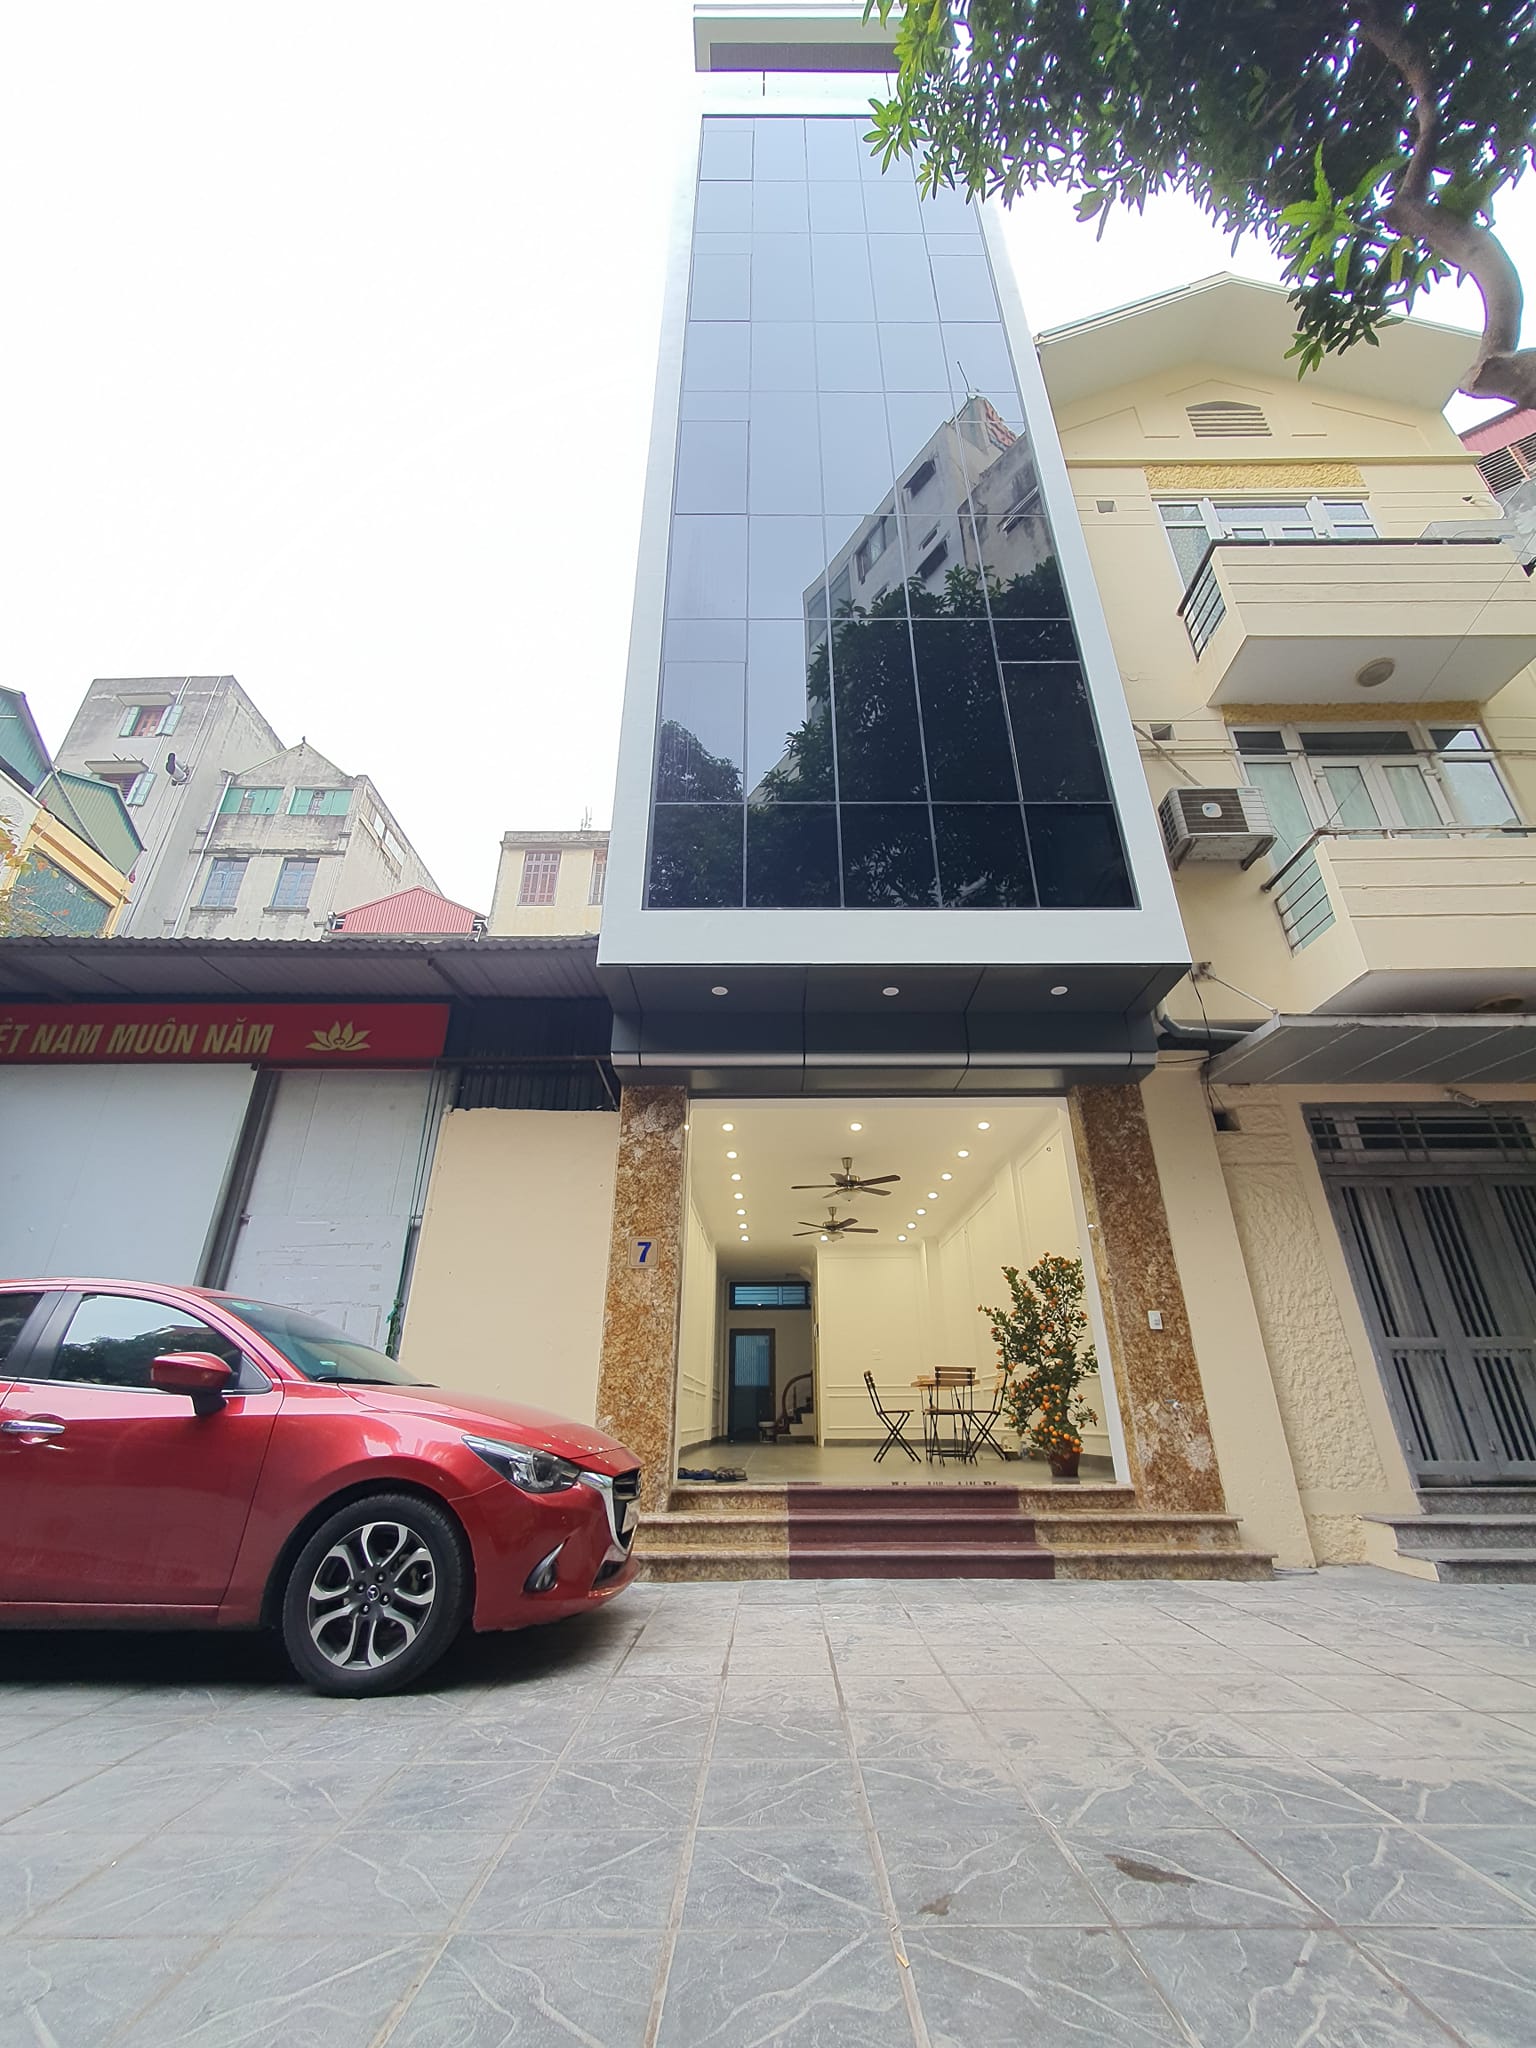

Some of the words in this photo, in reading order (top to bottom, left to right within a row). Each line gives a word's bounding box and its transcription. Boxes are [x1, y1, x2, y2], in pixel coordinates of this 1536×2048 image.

[28, 1023, 105, 1054] NAM
[105, 1016, 200, 1055] MUÔN
[201, 1016, 275, 1055] NĂM
[636, 1241, 652, 1263] 7
